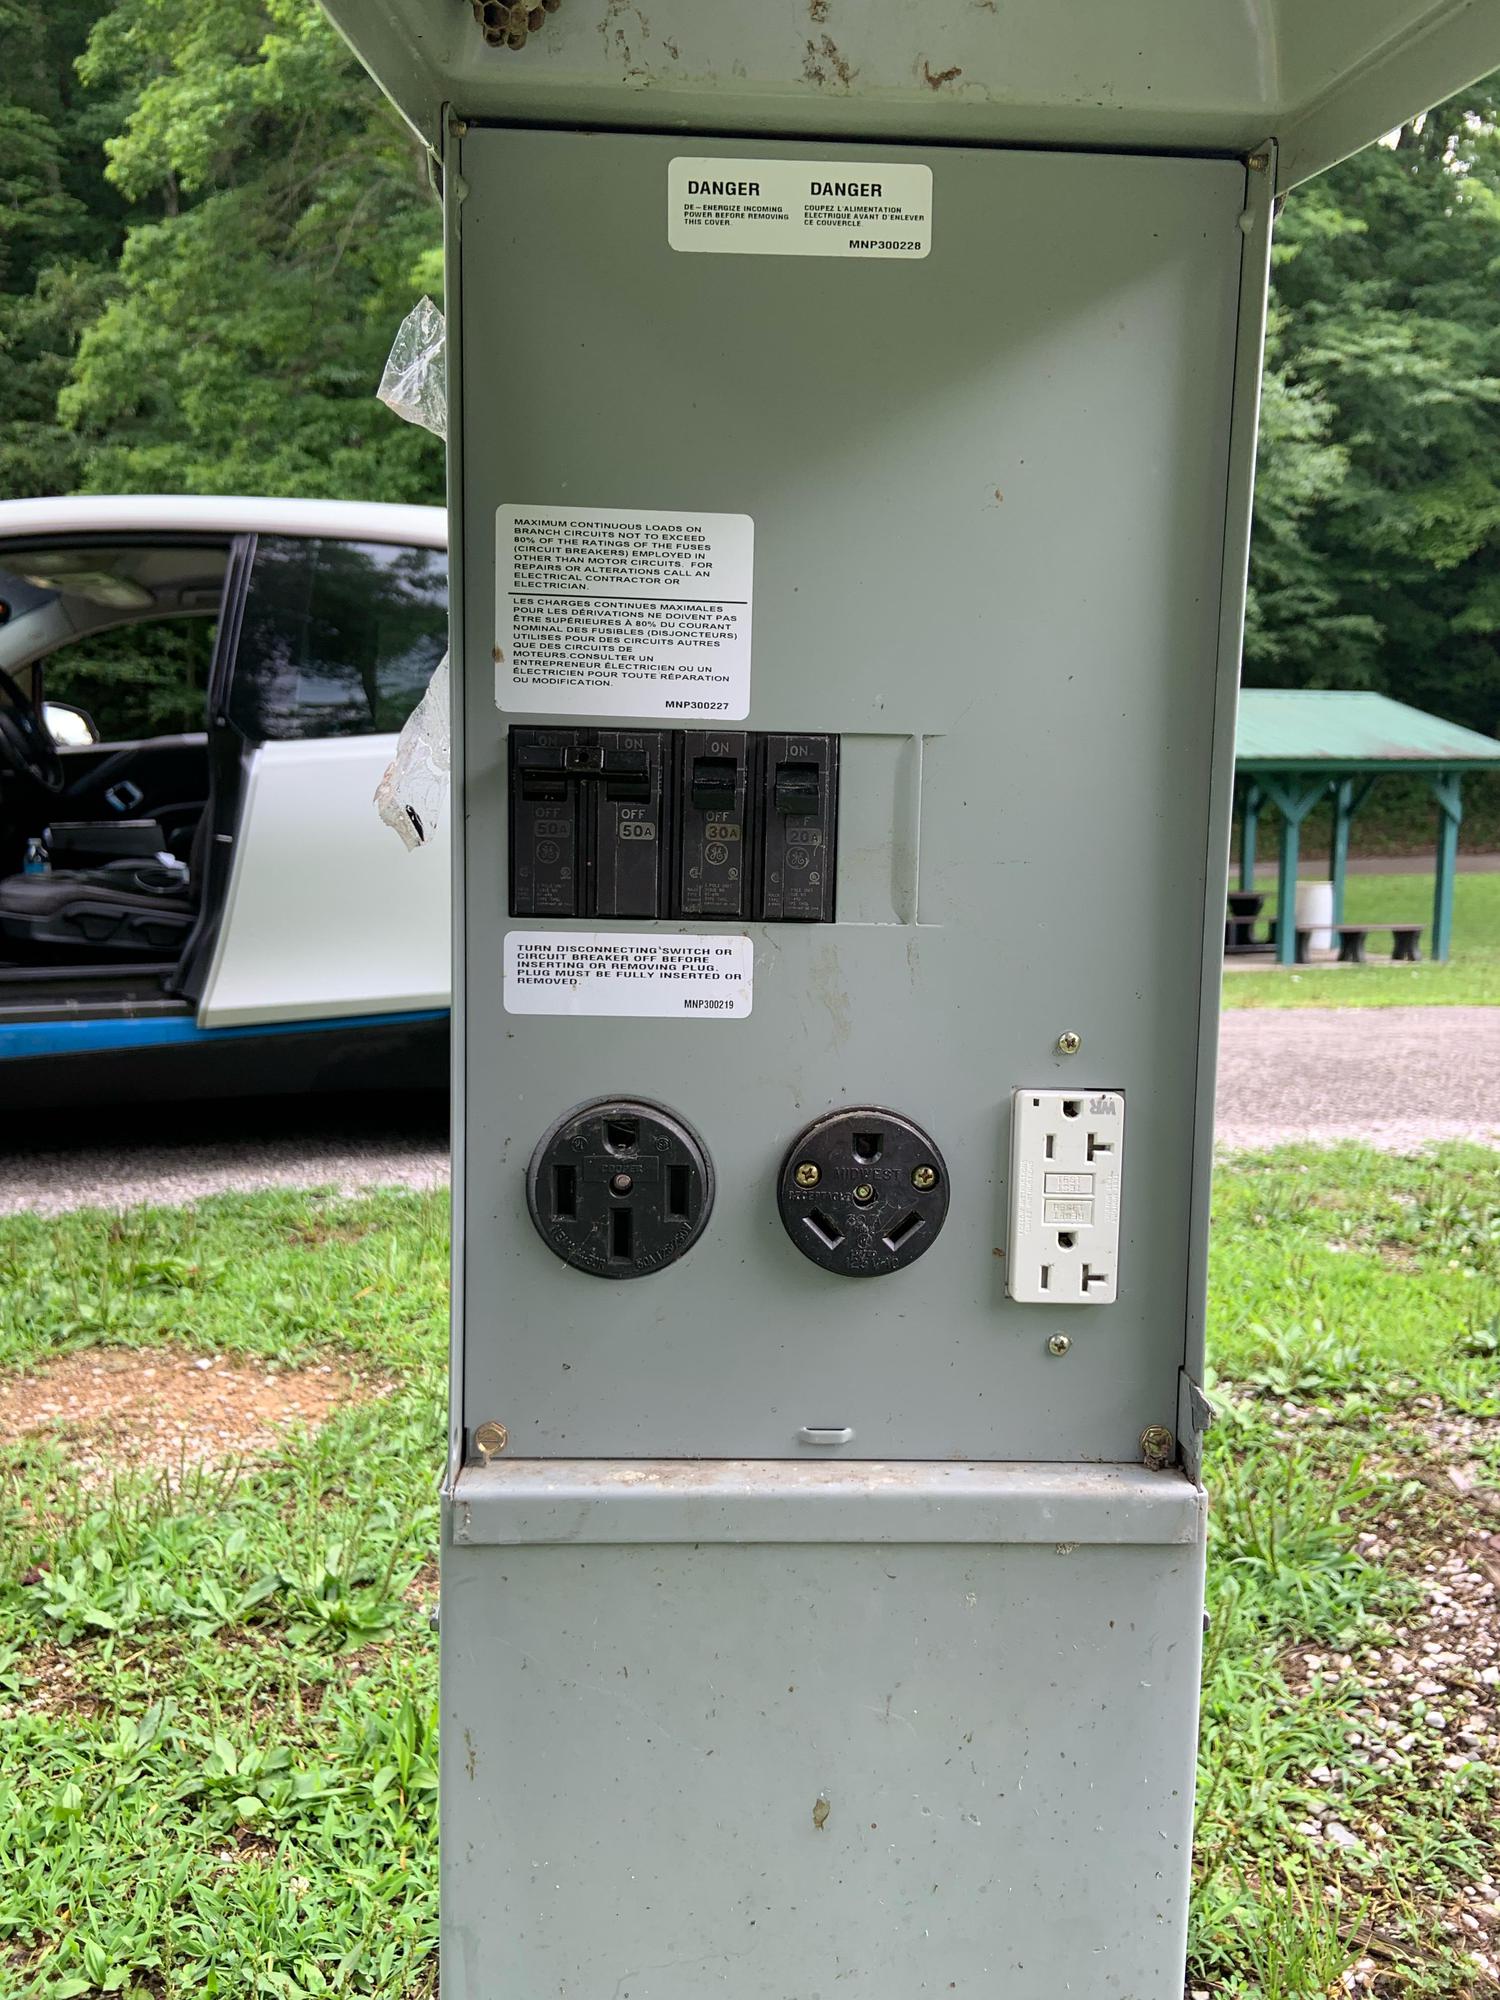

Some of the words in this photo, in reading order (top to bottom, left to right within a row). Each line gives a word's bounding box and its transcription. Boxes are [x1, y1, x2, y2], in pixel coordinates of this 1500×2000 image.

[688, 180, 759, 195] DANGER
[810, 182, 881, 197] DANGER
[881, 214, 924, 222] D'ENLEVER
[849, 240, 920, 250] MNP300228
[514, 519, 567, 527] MAXIMUM
[569, 521, 642, 530] CONTINUOUS
[645, 524, 682, 532] LOADS
[514, 527, 560, 535] BRANCH
[563, 529, 614, 538] CIRCUITS
[661, 533, 705, 541] EXCEED
[582, 539, 630, 547] RATINGS
[513, 545, 562, 553] (CIRCUIT
[564, 547, 628, 556] BREAKERS)
[632, 550, 691, 558] EMPLOYED
[513, 554, 551, 562] OTHER
[587, 557, 627, 565] MOTOR
[630, 559, 683, 567] CIRCUITS.
[514, 563, 561, 571] REPAIRS
[583, 566, 660, 575] ALTERATIONS
[513, 572, 582, 581] ELECTRICAL
[584, 575, 660, 584] CONTRACTOR
[514, 580, 588, 589] ELECTRICIAN.
[536, 599, 590, 607] CHARGES
[593, 601, 656, 610] CONTINUES
[660, 604, 722, 612] MAXIMALES
[513, 606, 543, 614] POUR
[571, 609, 644, 618] DÉRIVATIONS
[665, 612, 712, 620] DOIVENT
[678, 621, 730, 630] COURANT
[512, 624, 562, 632] NOMINAL
[591, 627, 644, 635] FUSIBLES
[646, 629, 737, 639] (DISJONCTEURS)
[564, 643, 614, 651] CIRCUITS
[623, 637, 673, 645] CIRCUITS
[676, 639, 720, 647] AUTRES
[512, 659, 600, 668] ENTREPRENEUR
[604, 662, 674, 671] ÉLECTRICIEN
[512, 667, 584, 676] ÉLECTRICIEN
[660, 673, 729, 682] RÉPARATION
[665, 700, 728, 710] MNP300227
[624, 738, 643, 749] ON
[711, 742, 729, 752] ON
[790, 746, 808, 756] ON
[535, 807, 560, 818] OFF
[621, 808, 646, 819] OFF
[705, 811, 730, 822] OFF
[623, 825, 652, 838] 50A
[708, 826, 738, 839] 30A
[557, 946, 657, 954] DISCONNECTING
[662, 955, 708, 963] BEFORE
[659, 971, 720, 979] INSERTED
[684, 999, 733, 1008] MNP300219
[833, 1167, 902, 1181] MIDWEST
